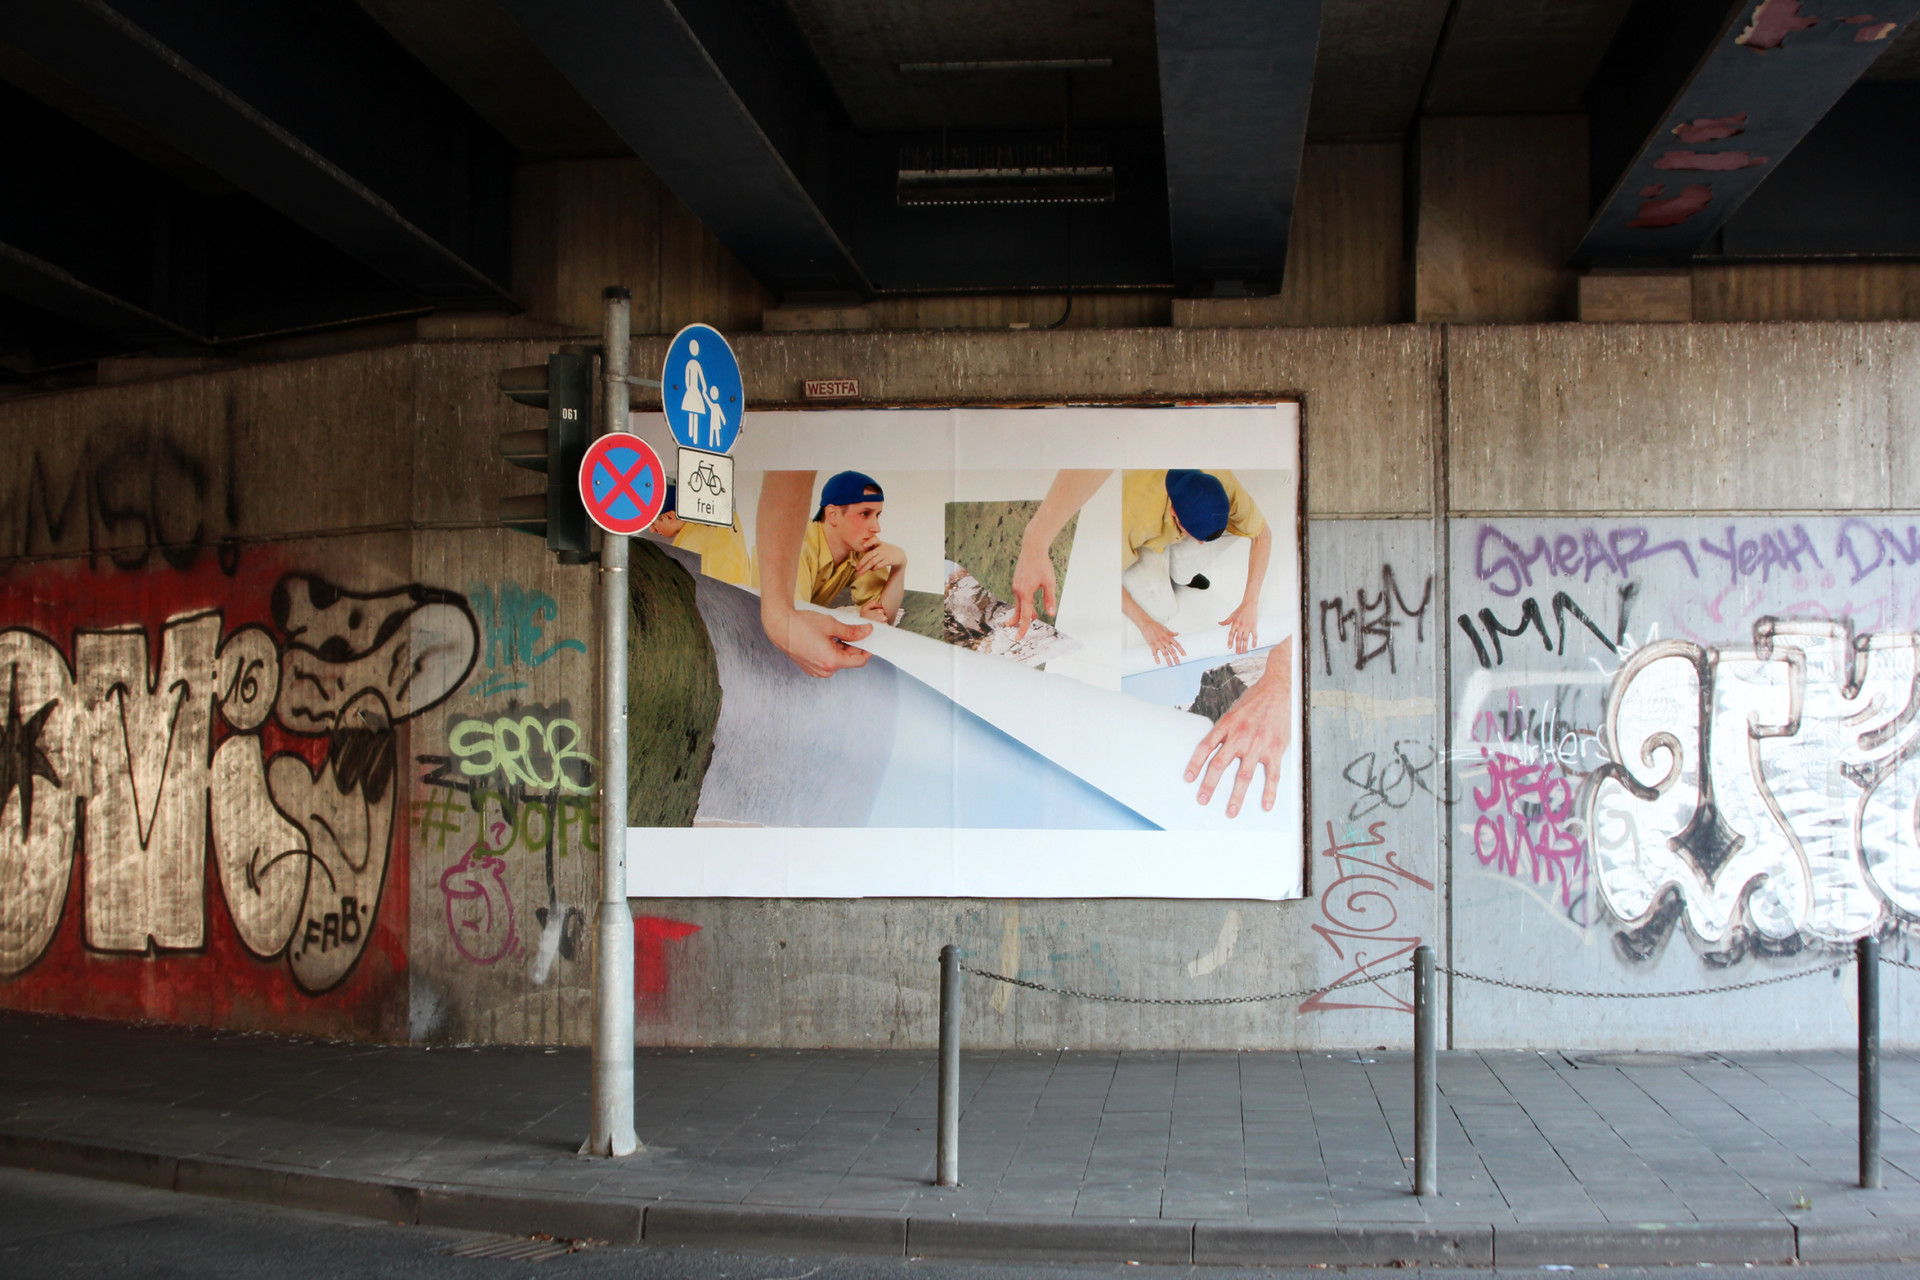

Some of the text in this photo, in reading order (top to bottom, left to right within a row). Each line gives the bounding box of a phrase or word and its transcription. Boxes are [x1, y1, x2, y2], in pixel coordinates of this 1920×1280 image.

[807, 381, 857, 395] WESTFA
[562, 407, 577, 420] 061
[697, 498, 715, 515] frei
